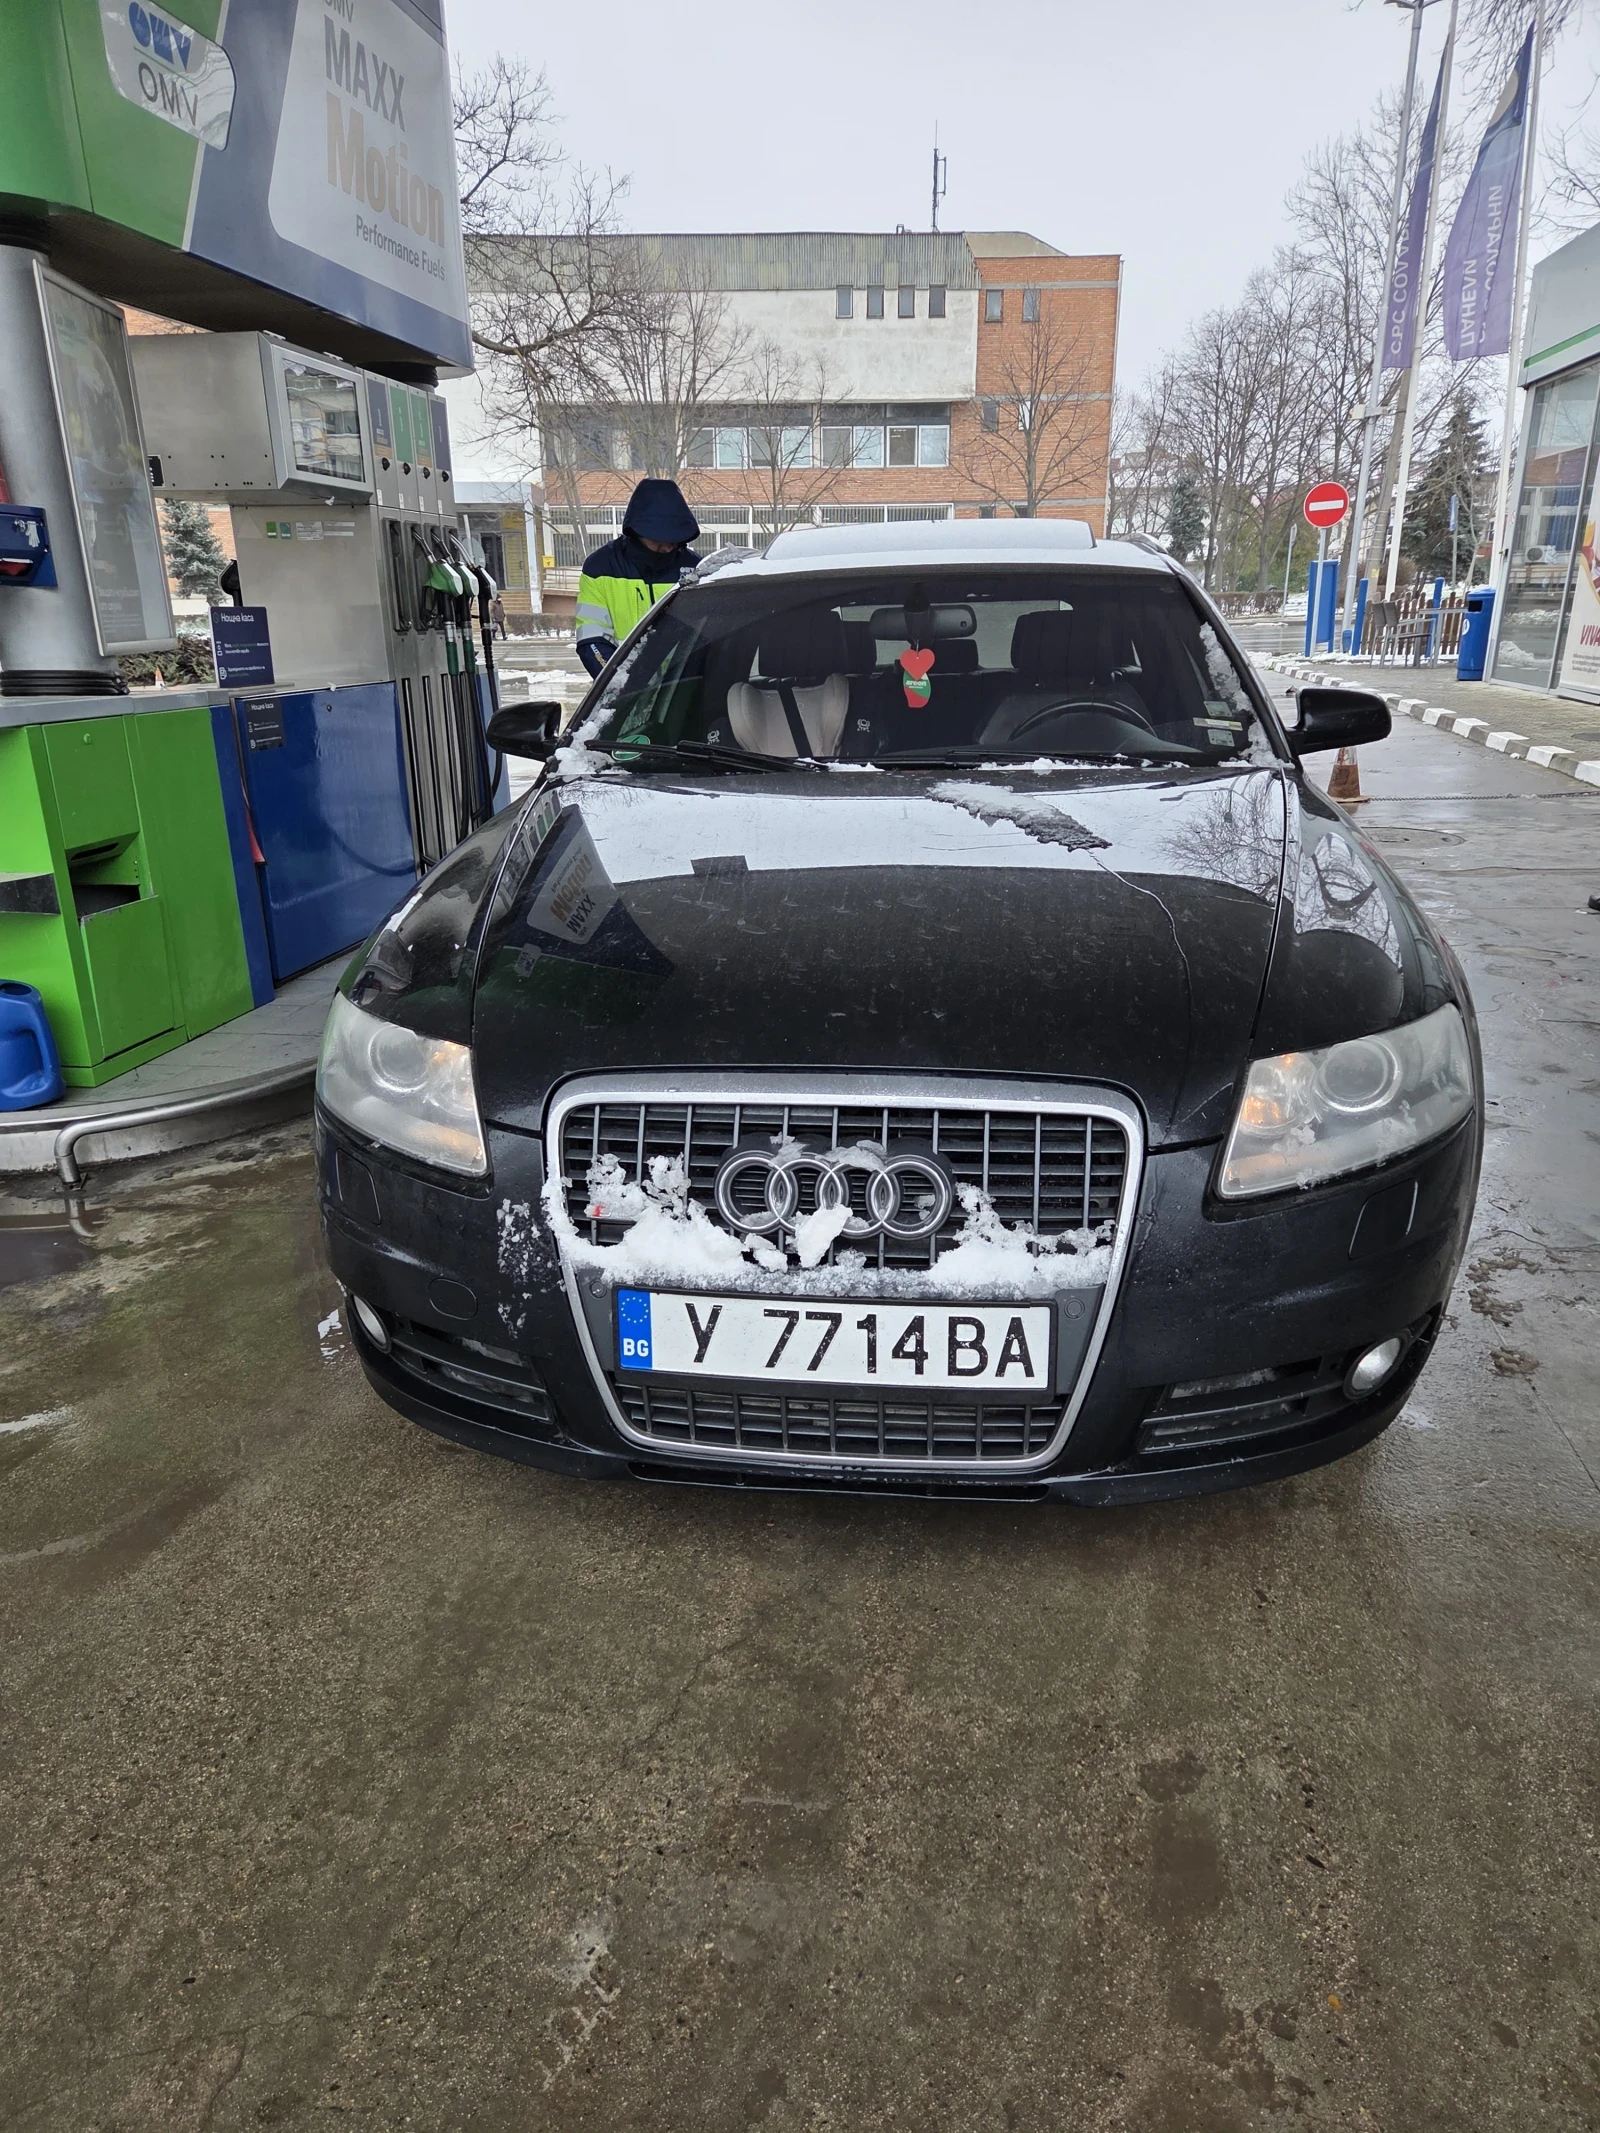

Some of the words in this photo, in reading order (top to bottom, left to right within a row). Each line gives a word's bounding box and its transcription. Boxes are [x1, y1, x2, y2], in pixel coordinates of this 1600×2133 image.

[128, 2, 192, 72] OMV
[138, 62, 198, 126] OMV
[324, 14, 406, 132] MAXX
[325, 91, 446, 248] Motion
[355, 214, 420, 269] Performance
[421, 248, 446, 282] Fuels
[623, 1338, 649, 1357] BG
